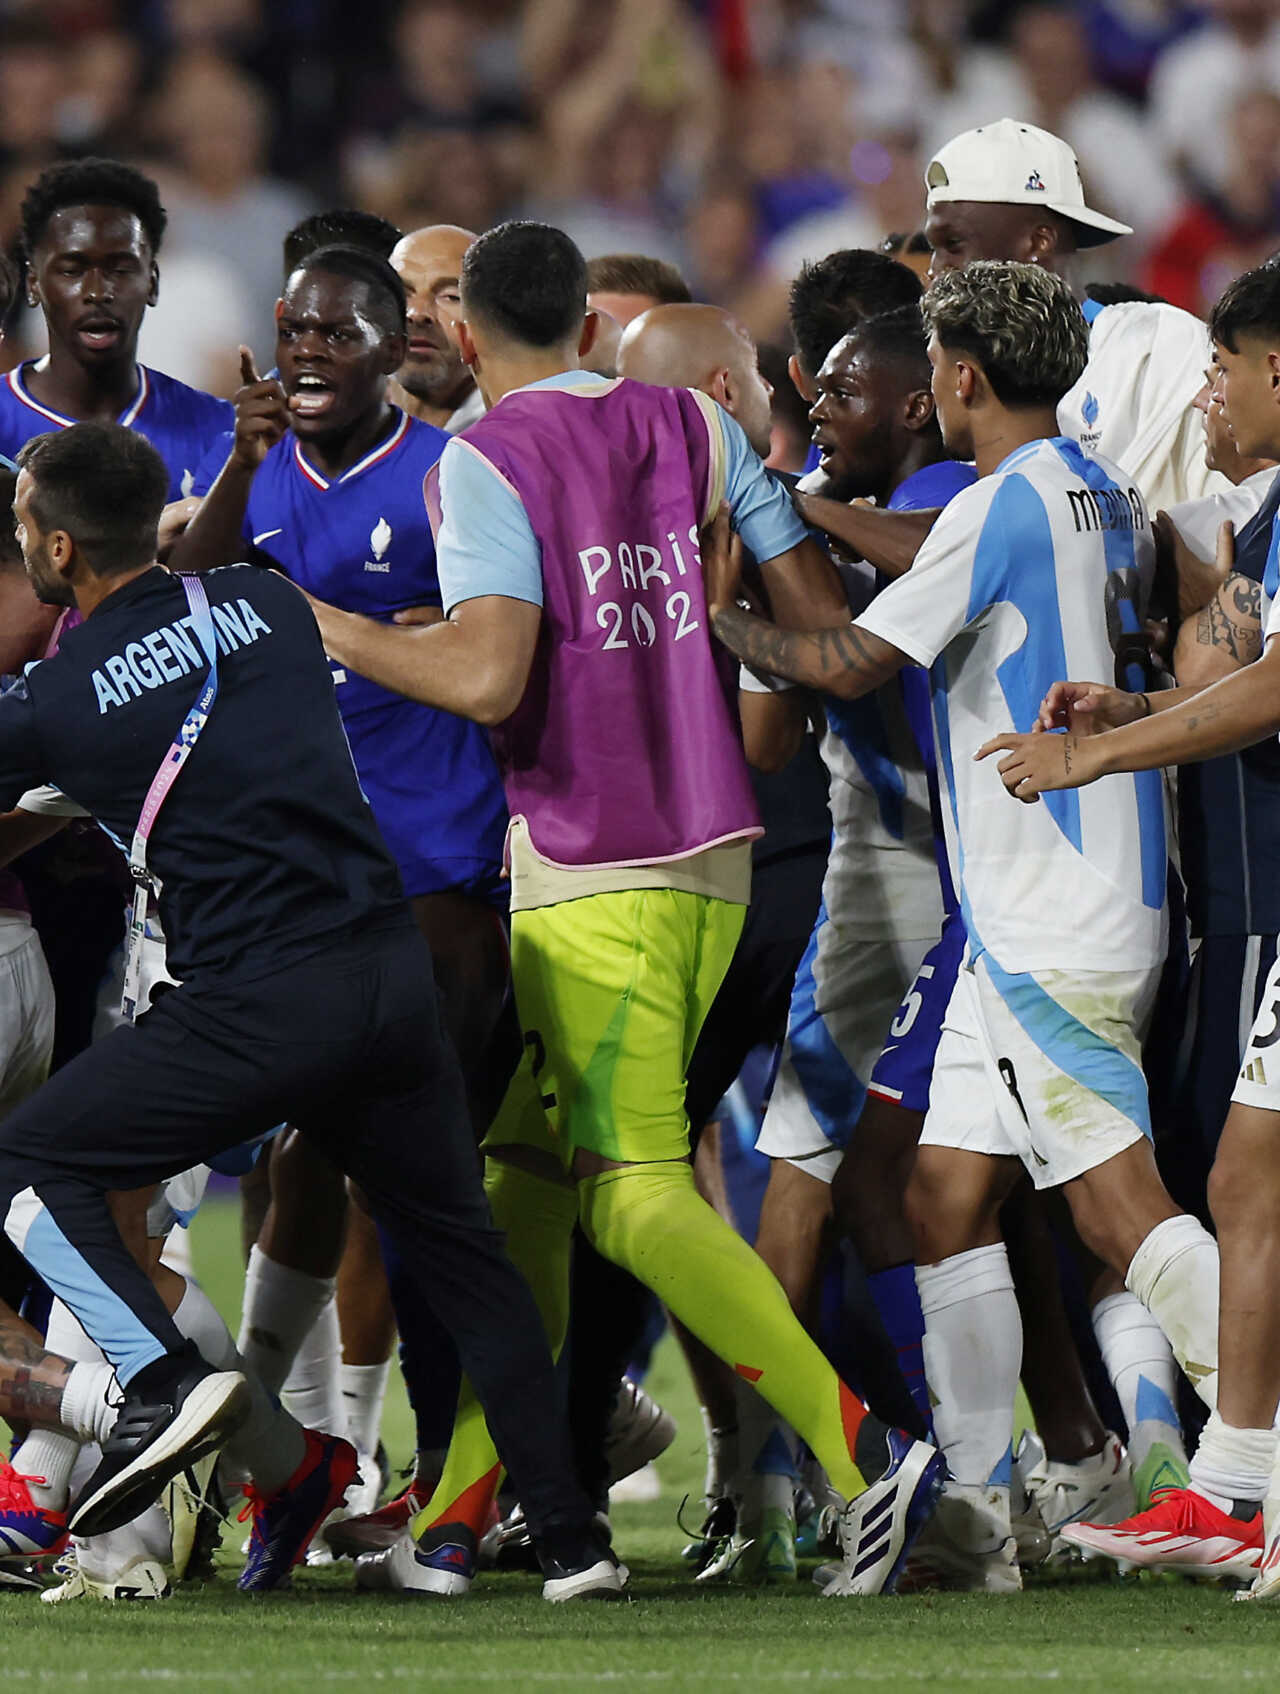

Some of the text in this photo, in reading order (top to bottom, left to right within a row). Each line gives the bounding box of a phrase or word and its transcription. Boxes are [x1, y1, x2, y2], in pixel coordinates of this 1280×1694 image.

[1080, 430, 1103, 443] FRANC
[1066, 486, 1145, 532] MEDINA
[364, 561, 391, 573] FRANCE
